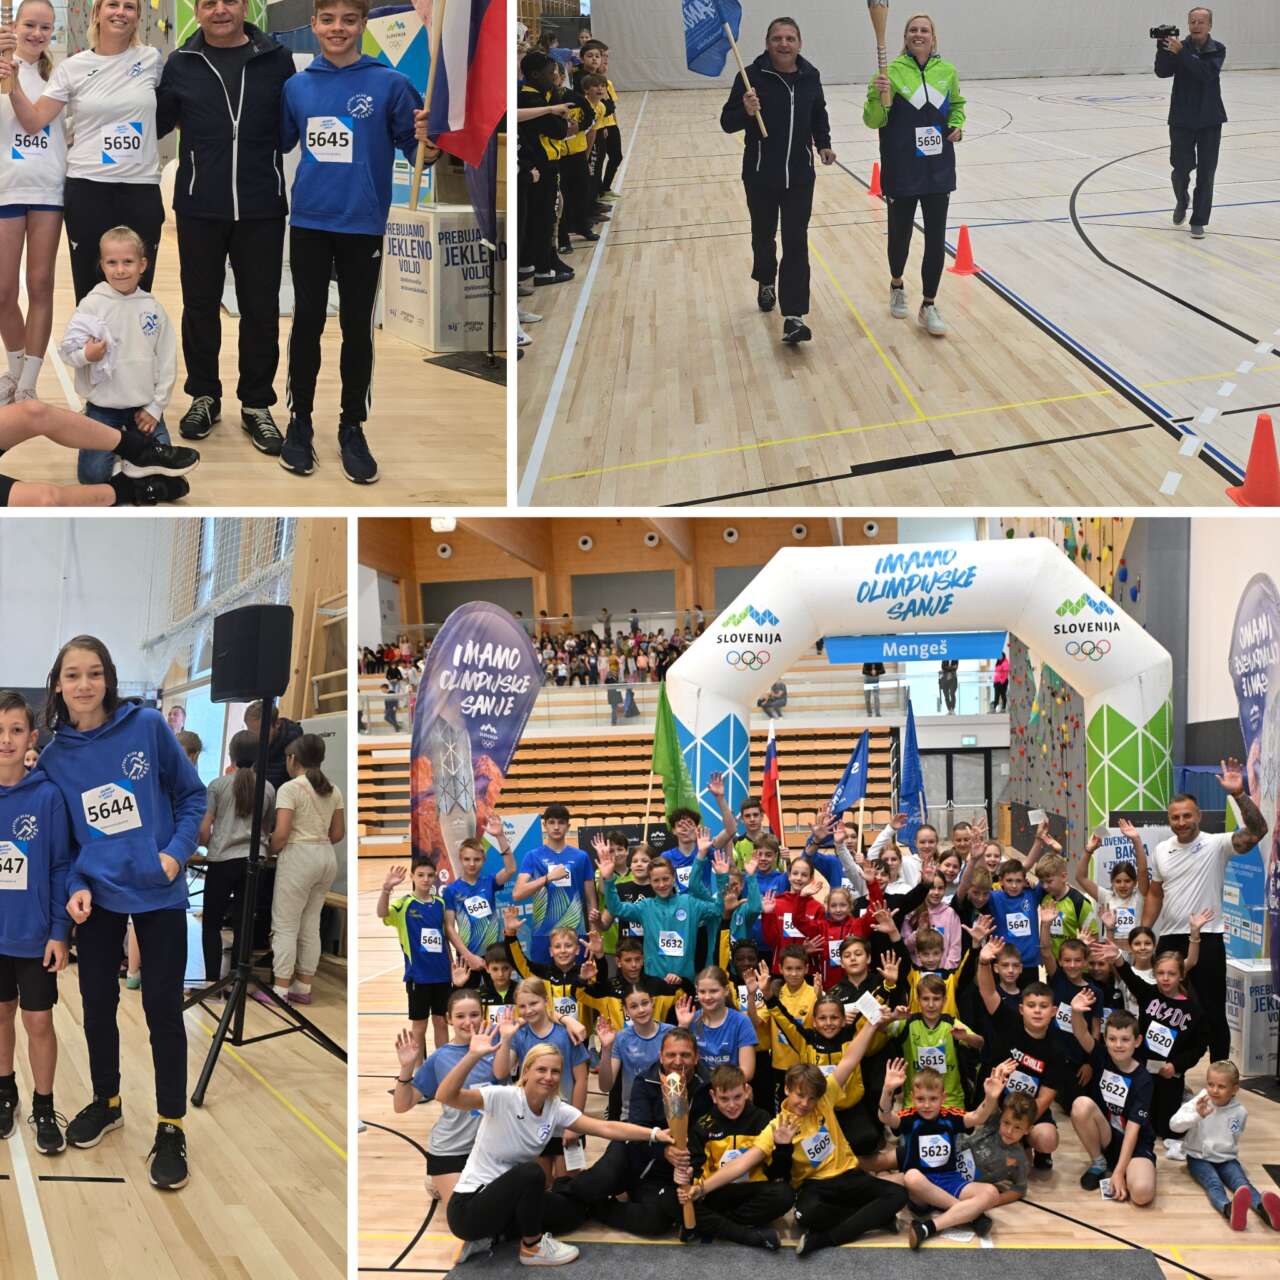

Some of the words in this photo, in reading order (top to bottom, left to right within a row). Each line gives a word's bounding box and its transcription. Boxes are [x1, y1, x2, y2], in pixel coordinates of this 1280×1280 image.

[15, 133, 48, 149] 5646
[104, 135, 141, 151] 5650
[308, 131, 350, 148] 5645
[917, 135, 941, 147] 5650
[438, 228, 482, 245] PREBUJA
[387, 238, 433, 261] JEKLENO
[444, 241, 507, 267] JEKLEO
[399, 259, 421, 274] VOLJO
[875, 549, 958, 575] IMAMO
[856, 565, 977, 604] OLIMPIJSKE
[886, 593, 955, 622] SANJE
[1054, 622, 1121, 636] SLOVENIJA
[716, 633, 782, 645] SLOVENIJA
[453, 640, 521, 670] IMAMO
[882, 639, 948, 659] Mengeš
[439, 671, 531, 694] OLIMPIJSKE
[460, 695, 515, 718] SANJE
[87, 795, 134, 822] 5644
[1115, 843, 1149, 860] BAKA
[468, 901, 489, 914] 5642
[1008, 920, 1029, 930] 5647
[422, 935, 442, 945] 5641
[660, 938, 683, 949] 5632
[1145, 998, 1192, 1032] AC/DC
[1146, 1031, 1173, 1049] 5620
[920, 1055, 945, 1065] 5615
[1008, 1079, 1036, 1094] 5624
[1101, 1079, 1126, 1099] 5622
[807, 1134, 831, 1160] 5605
[921, 1144, 949, 1157] 5623
